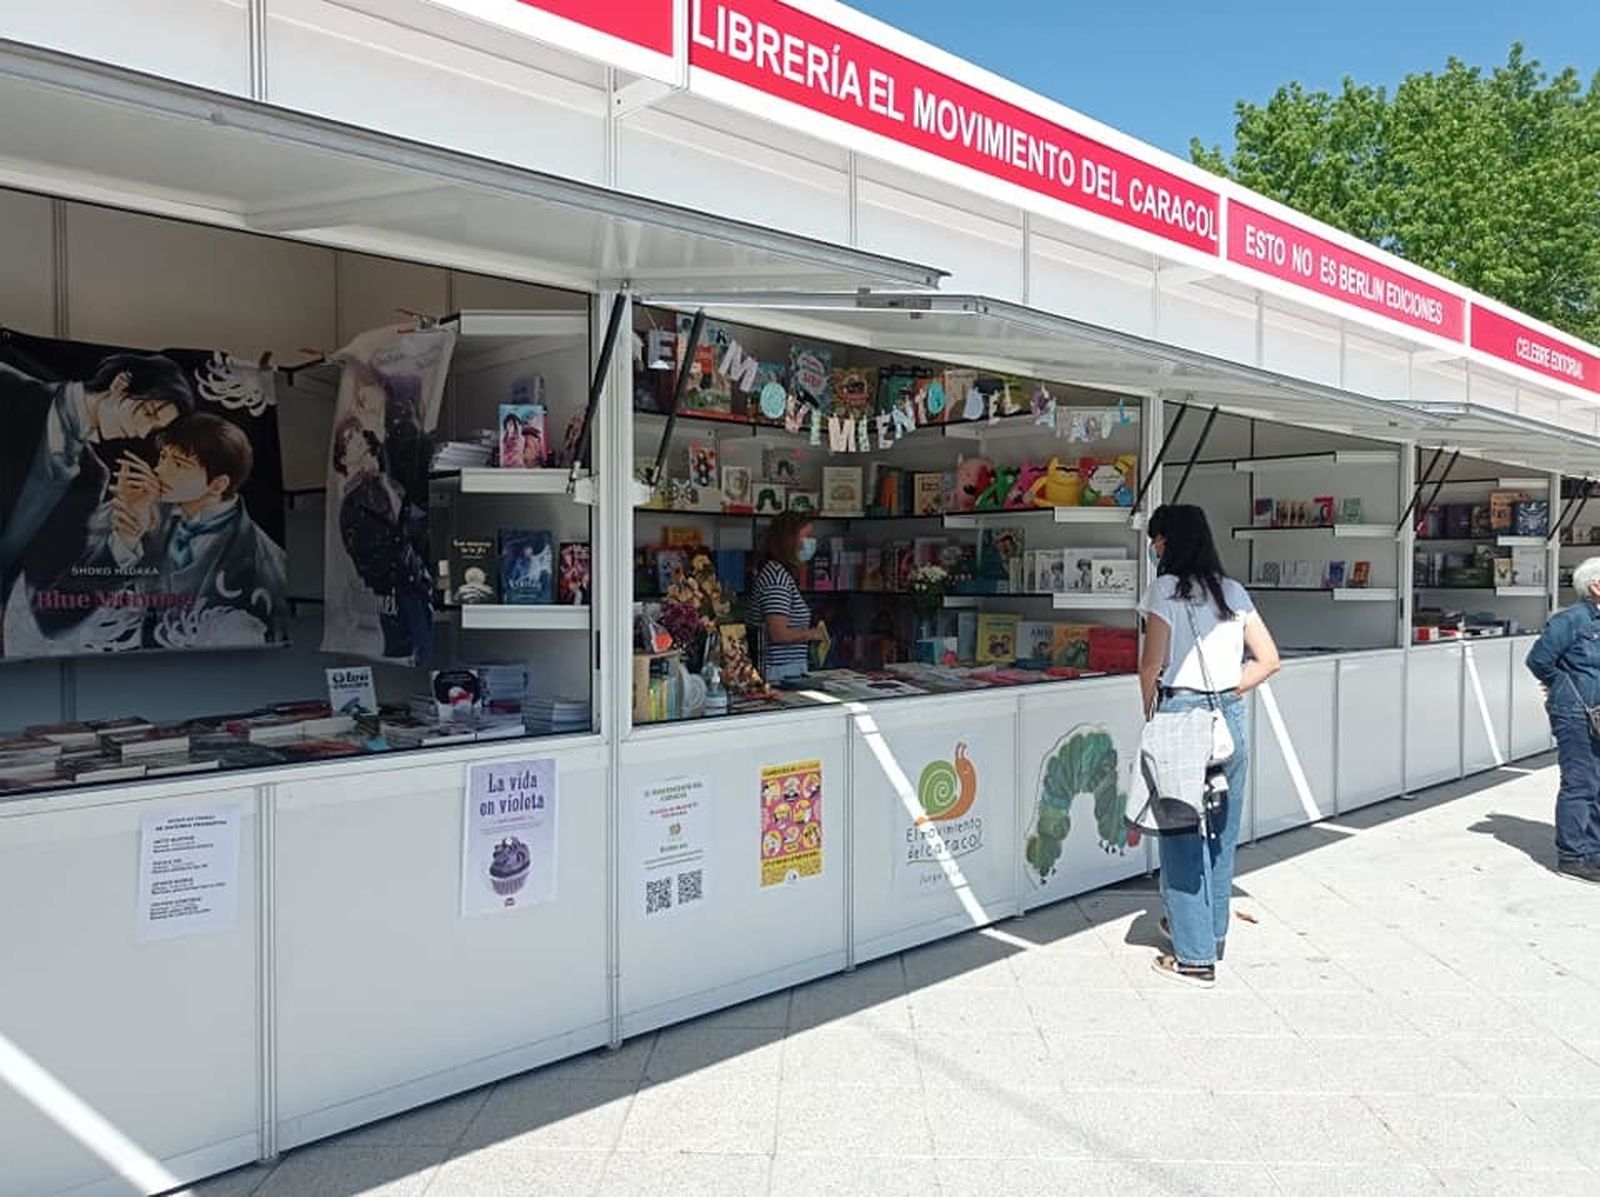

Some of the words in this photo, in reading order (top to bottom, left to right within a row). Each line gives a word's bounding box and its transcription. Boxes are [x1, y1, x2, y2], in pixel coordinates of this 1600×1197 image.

[691, 0, 863, 107] LIBRERÍA
[869, 69, 905, 122] EL
[913, 87, 1076, 187] MOVIMIENTO
[1081, 158, 1124, 207] DEL
[1129, 179, 1219, 244] CARACOL
[1245, 224, 1286, 267] ESTO
[1292, 243, 1313, 277] NO
[1320, 256, 1338, 287] ES
[1338, 264, 1385, 303] BERLIN
[1386, 282, 1443, 326] EDICIONES
[37, 589, 91, 610] Blue
[487, 772, 505, 793] La
[510, 770, 538, 792] vida
[479, 801, 495, 816] en
[500, 791, 544, 815] violeta
